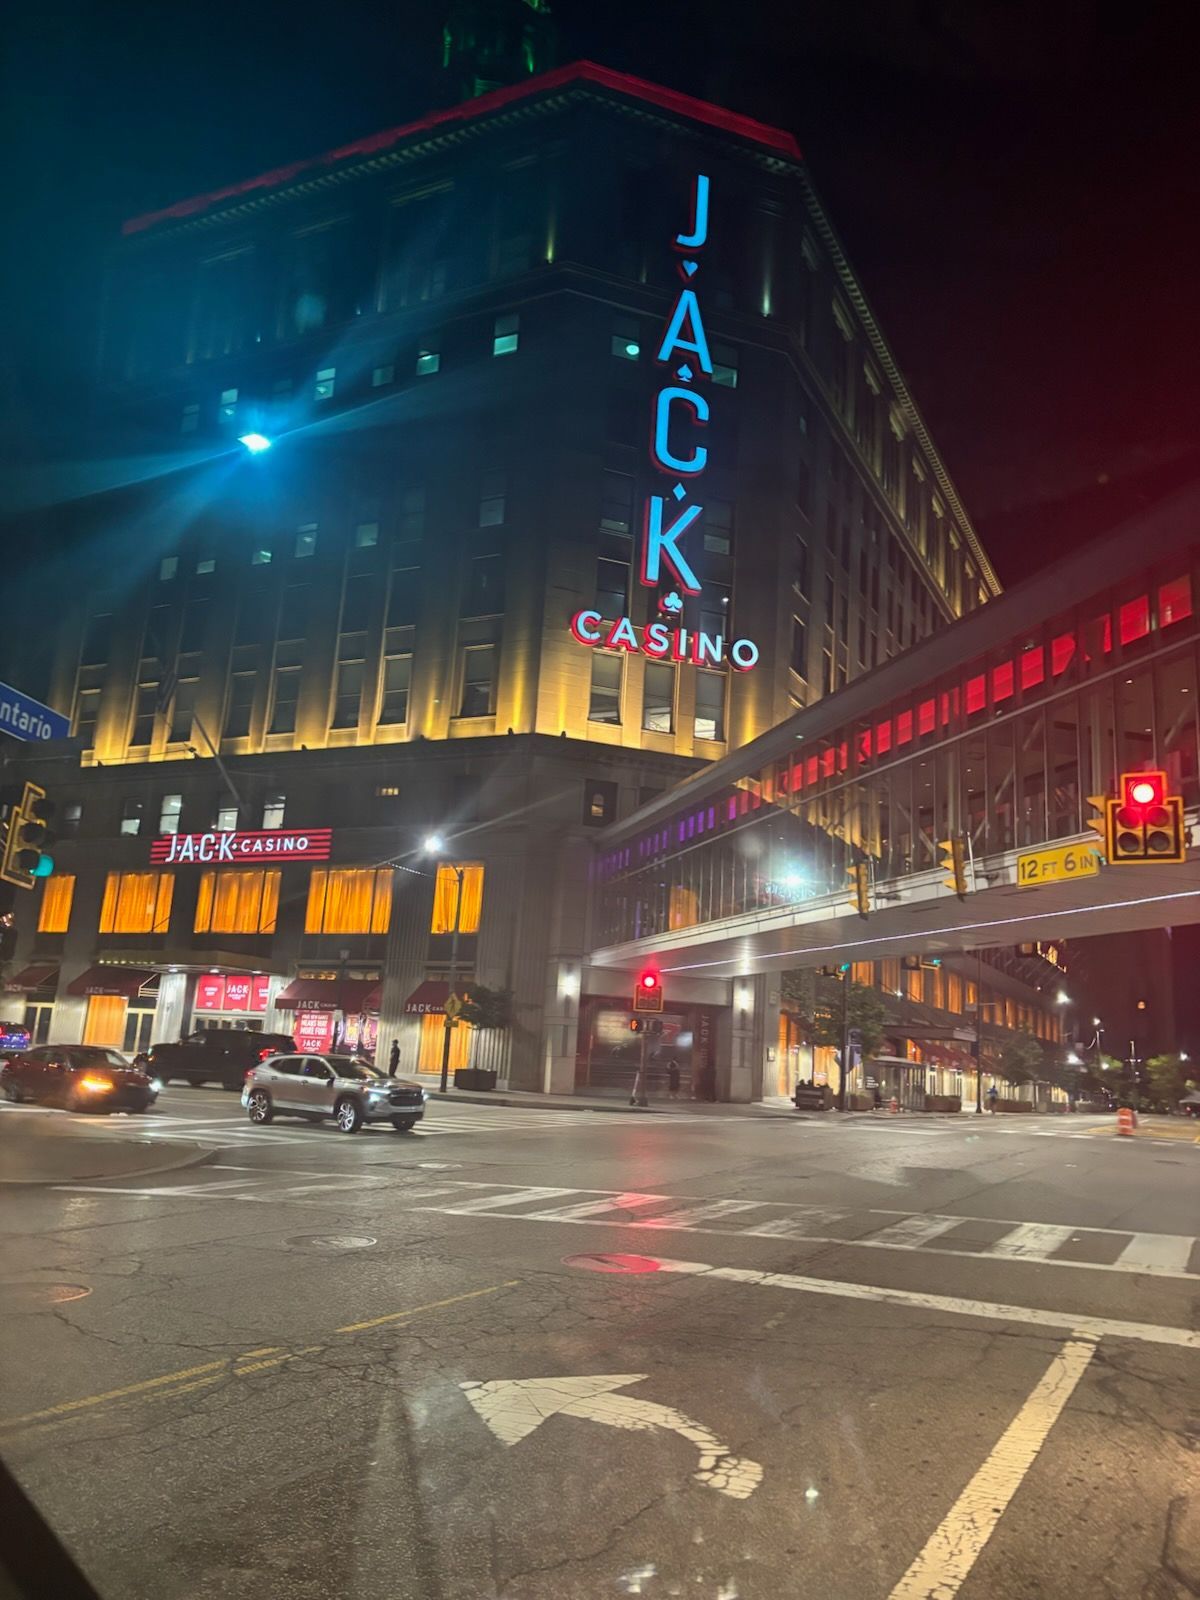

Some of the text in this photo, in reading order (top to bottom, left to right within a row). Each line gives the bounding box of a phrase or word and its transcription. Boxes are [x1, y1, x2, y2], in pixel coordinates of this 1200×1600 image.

[642, 174, 713, 592] JACK
[572, 609, 760, 671] CASINO
[0, 702, 52, 740] ntario
[164, 832, 309, 863] JACK CASINO
[1021, 852, 1093, 880] 12 FT 6 IN
[226, 984, 249, 994] JACK
[296, 1000, 320, 1009] JACK
[406, 1004, 431, 1013] JACK
[302, 1039, 321, 1047] JACK
